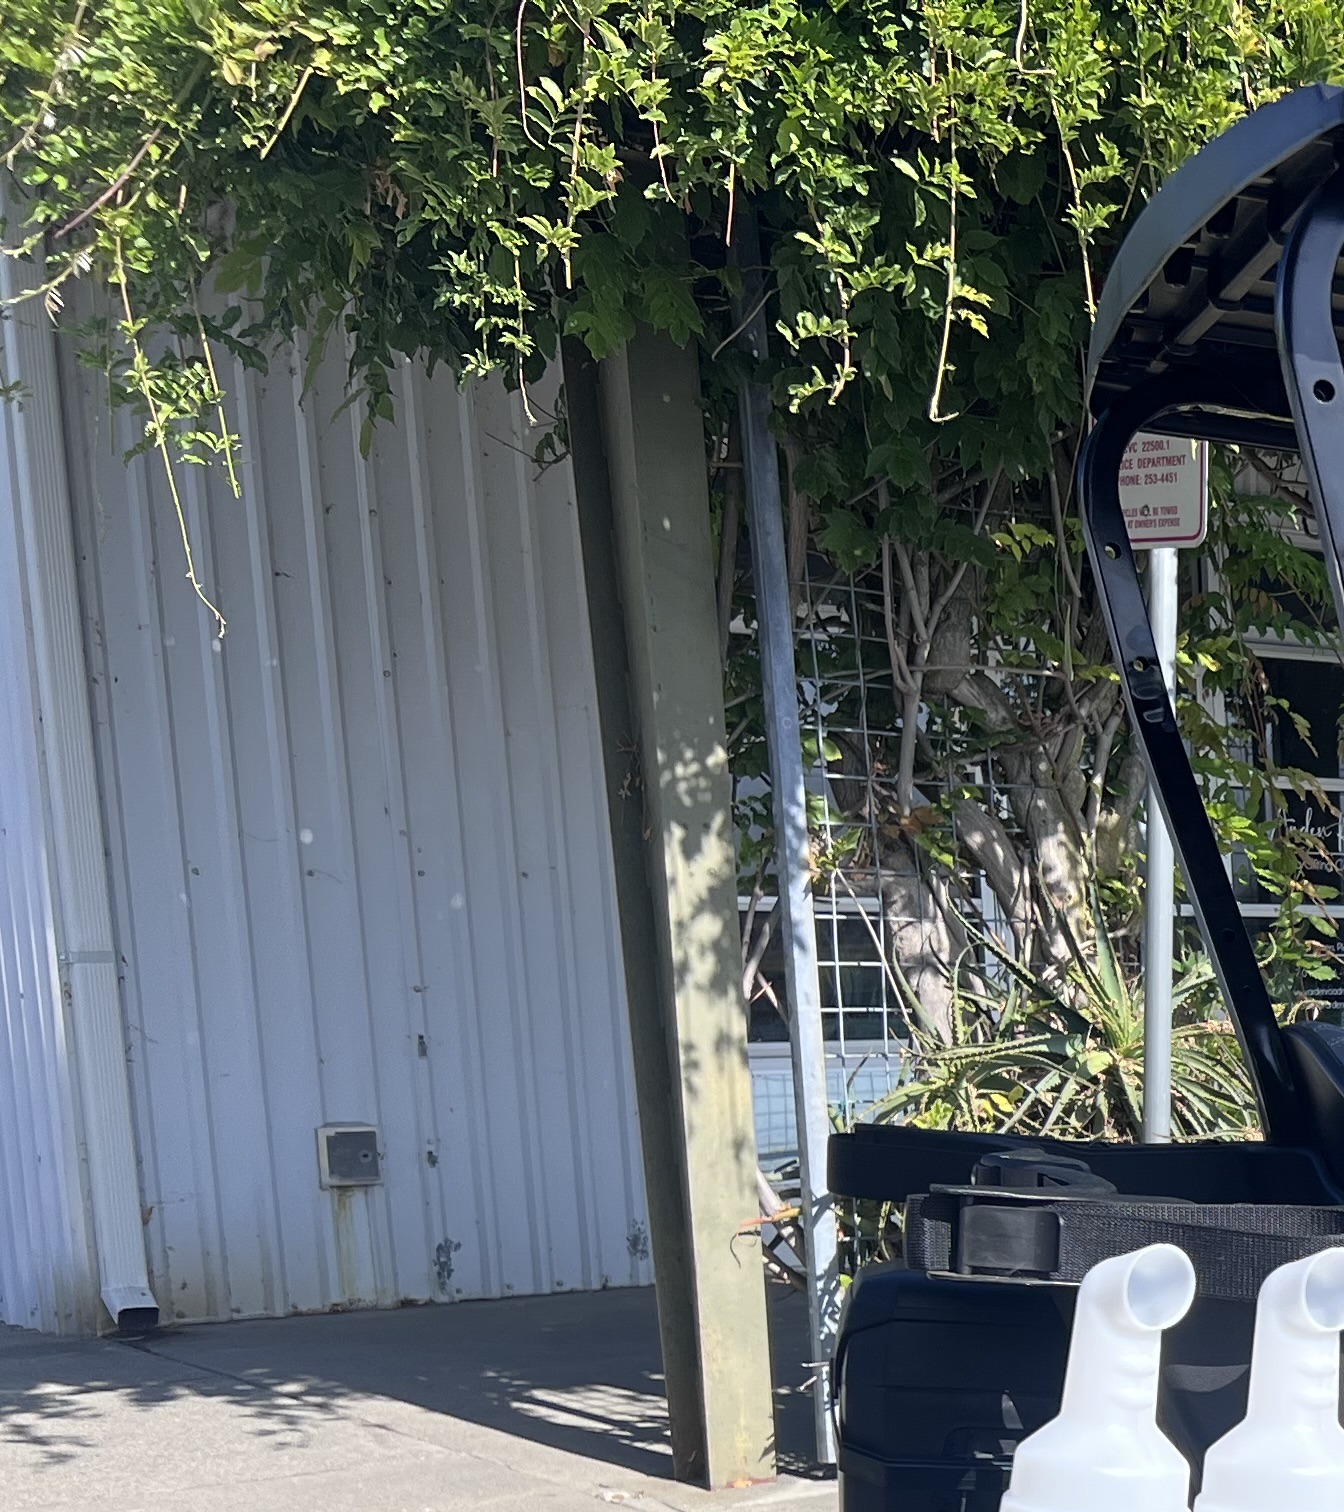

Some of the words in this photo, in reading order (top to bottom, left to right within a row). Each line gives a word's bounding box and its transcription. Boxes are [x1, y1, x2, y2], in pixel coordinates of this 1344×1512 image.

[1141, 440, 1170, 452] 22500.1
[1137, 454, 1186, 469] DEPARTMENT
[1119, 474, 1143, 486] HONE:
[1144, 472, 1178, 485] 253-4451
